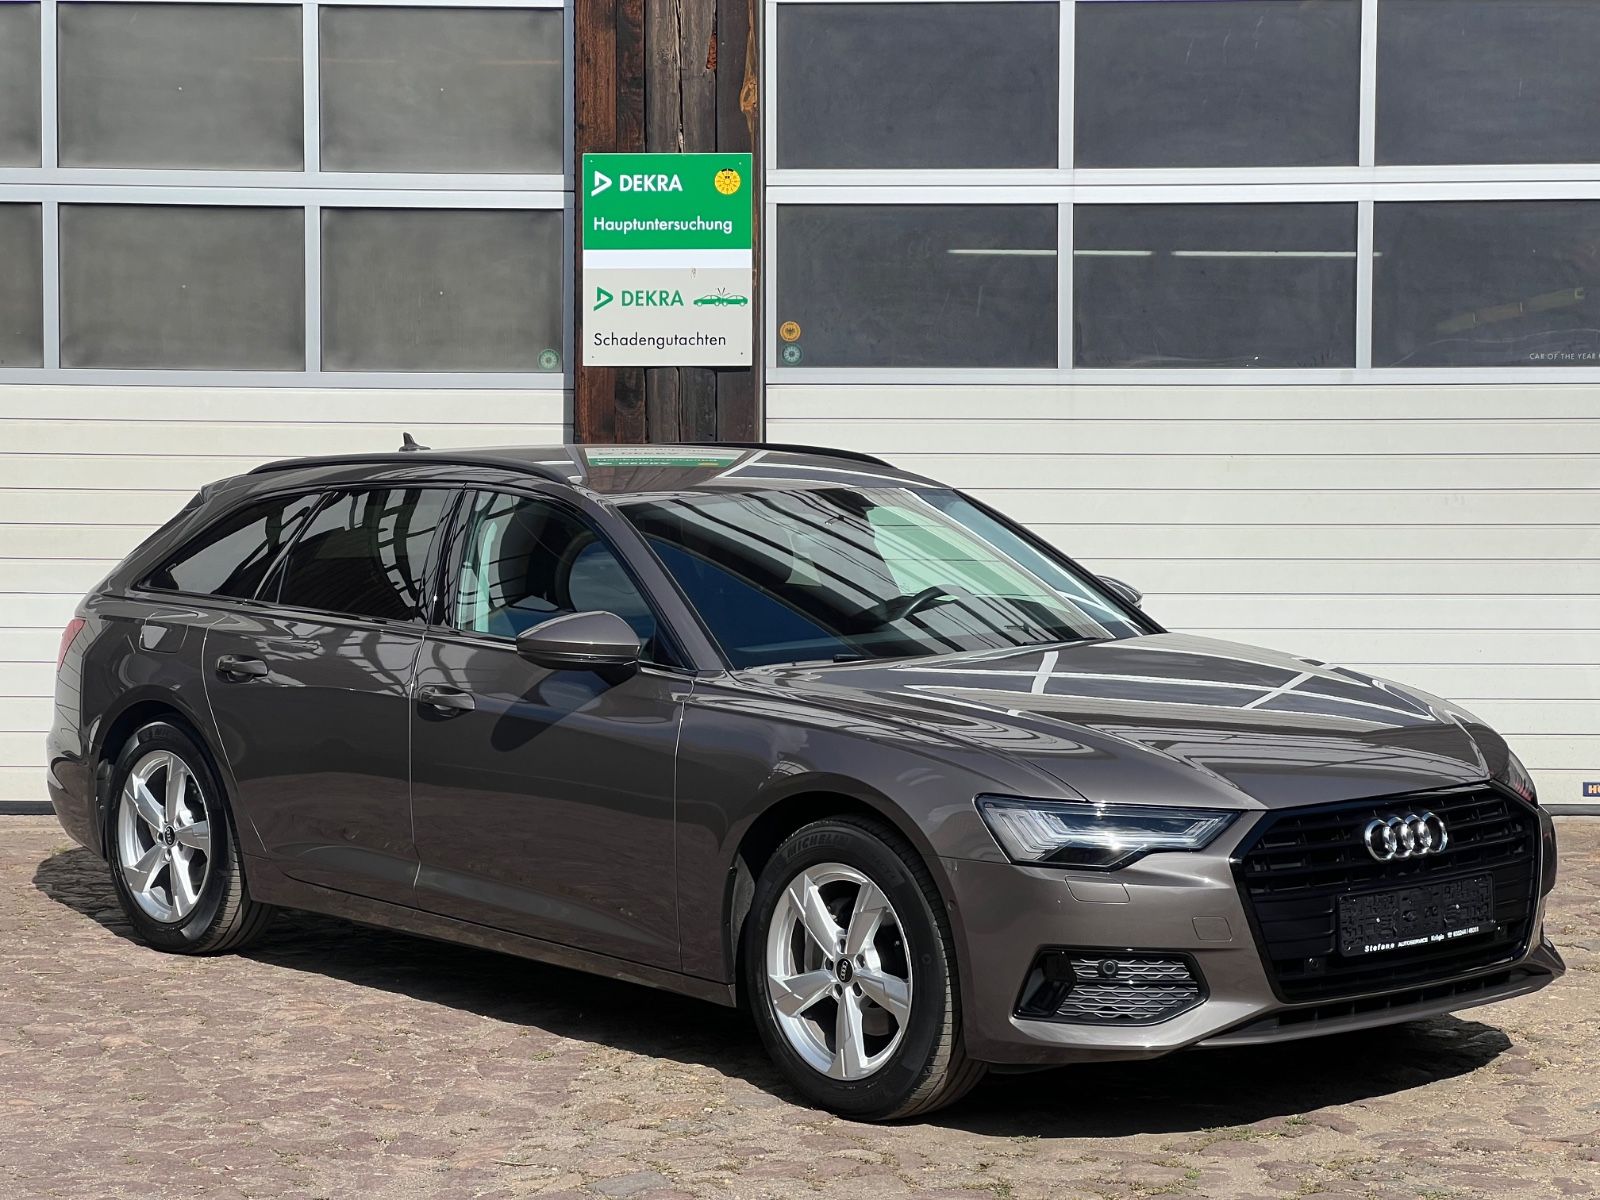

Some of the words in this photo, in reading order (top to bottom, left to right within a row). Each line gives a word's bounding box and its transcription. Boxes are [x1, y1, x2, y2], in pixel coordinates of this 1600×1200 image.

[619, 174, 683, 192] DEKRA
[593, 215, 733, 235] Hauptuntersuchung
[621, 290, 685, 307] DEKRA
[593, 332, 727, 350] Schadengutachten
